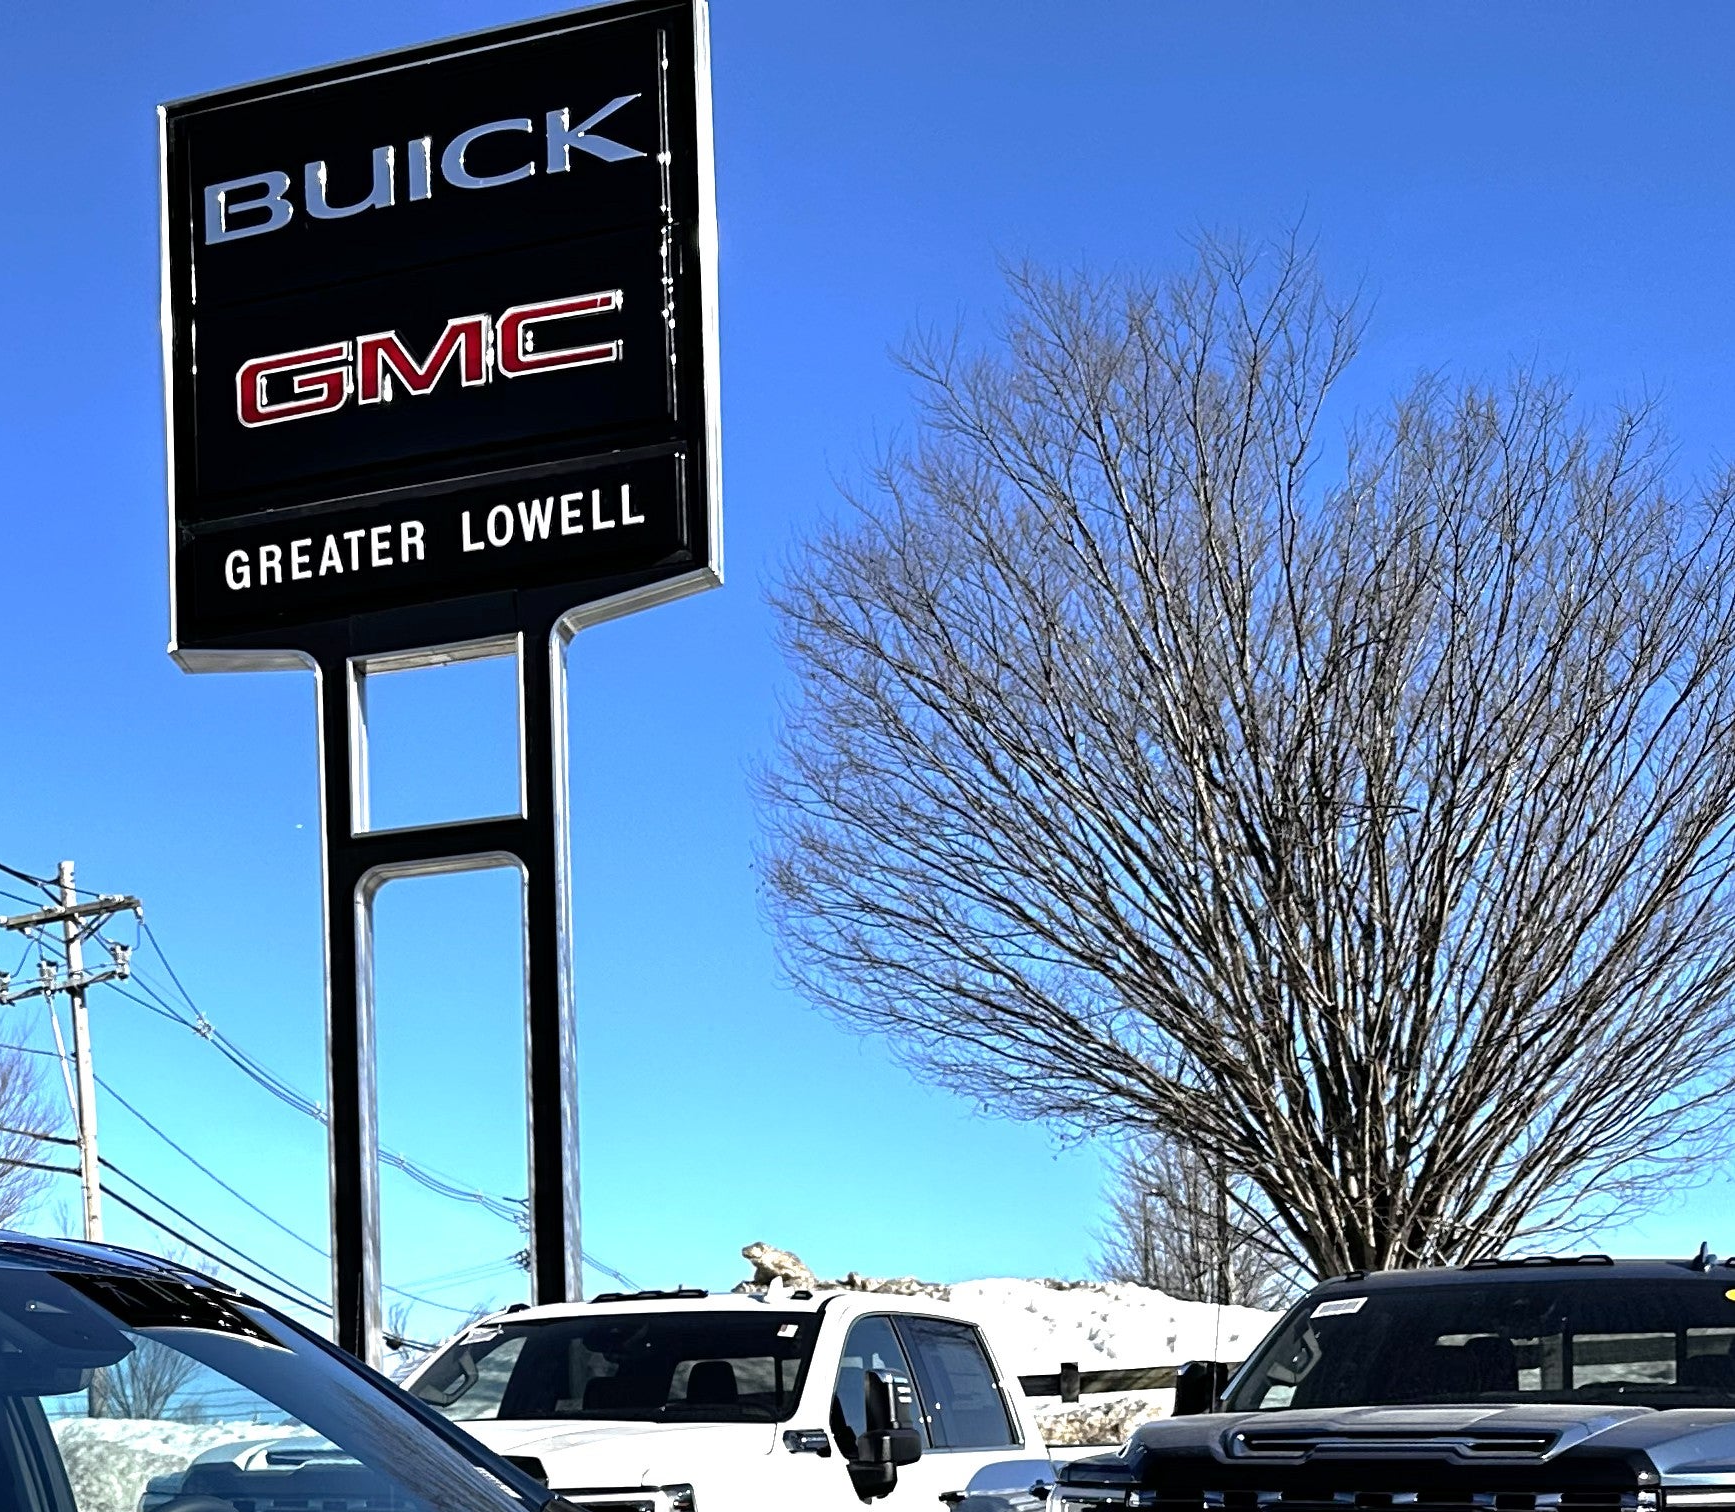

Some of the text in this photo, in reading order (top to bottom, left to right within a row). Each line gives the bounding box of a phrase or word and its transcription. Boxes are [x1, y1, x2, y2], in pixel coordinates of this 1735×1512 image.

[204, 93, 648, 245] BUICK
[235, 289, 624, 428] GMC
[223, 483, 645, 590] GREATER LOWELL
